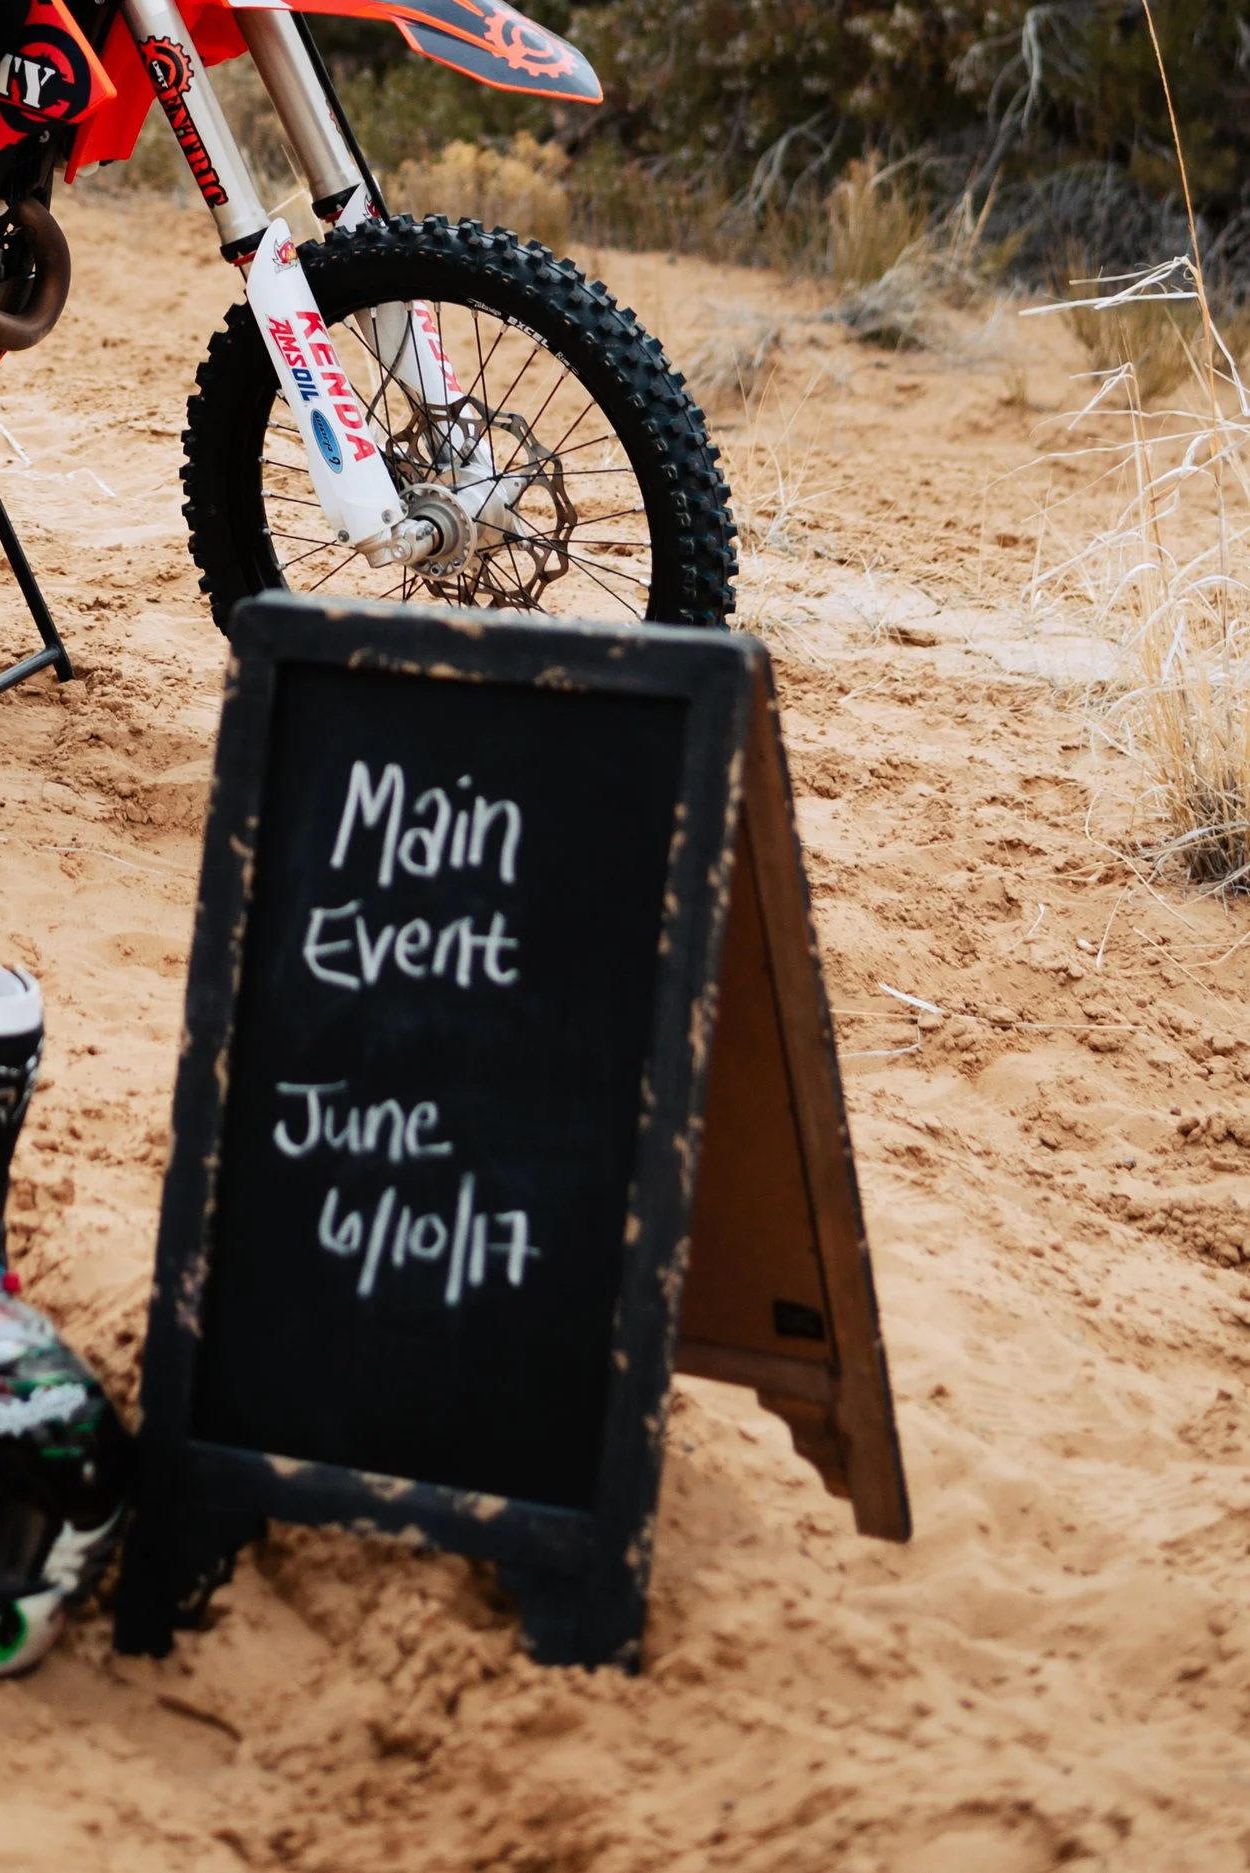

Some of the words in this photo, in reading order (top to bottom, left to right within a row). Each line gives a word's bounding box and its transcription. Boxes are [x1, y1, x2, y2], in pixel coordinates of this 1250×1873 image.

[266, 315, 320, 403] AMSOIL
[507, 315, 550, 349] EXCEL
[296, 311, 378, 462] KENDA
[329, 756, 526, 890] Main
[302, 899, 522, 991] Event
[272, 1080, 454, 1162] June
[316, 1171, 541, 1308] 6/10/17
